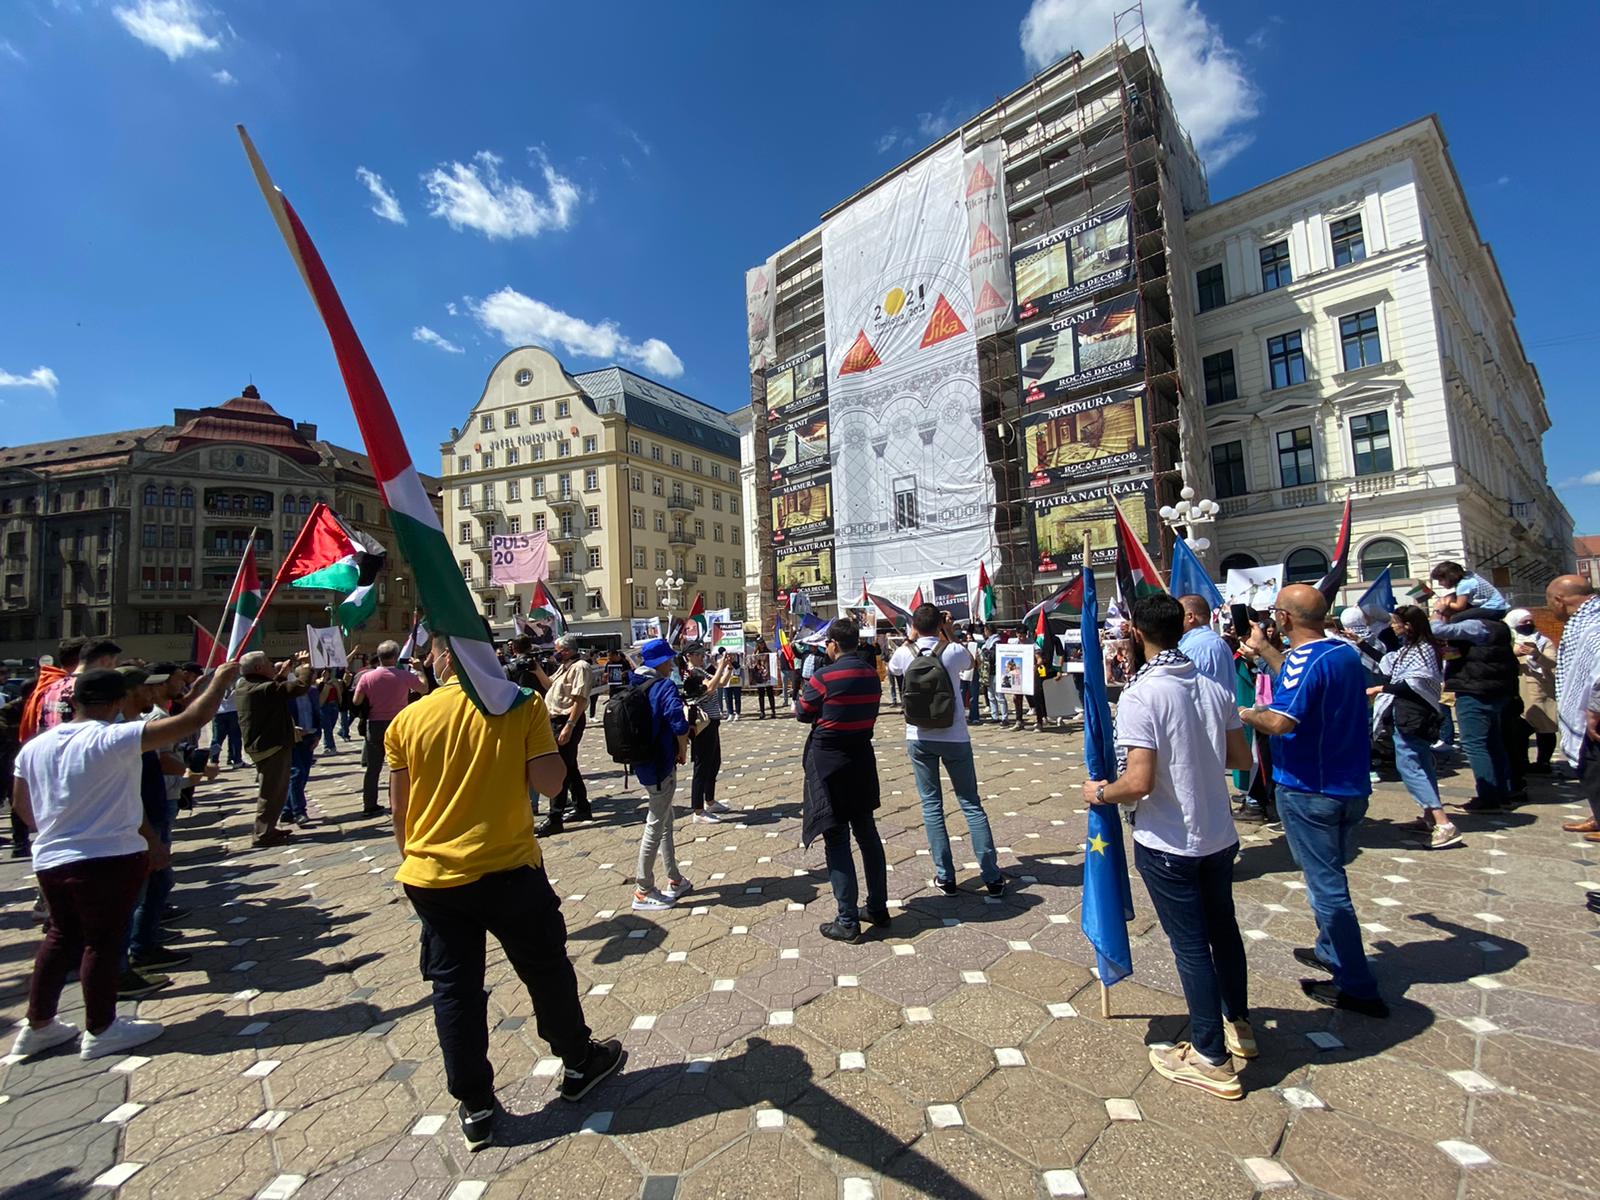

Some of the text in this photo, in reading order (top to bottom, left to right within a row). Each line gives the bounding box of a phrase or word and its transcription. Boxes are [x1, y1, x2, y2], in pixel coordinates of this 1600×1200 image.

[1035, 216, 1102, 250] TRAVERTIN
[1052, 282, 1085, 300] ROCAS
[1087, 269, 1122, 286] DECOR
[924, 308, 959, 343] Sika
[1049, 308, 1098, 331] GRANIT
[777, 353, 811, 373] TRAVERTIN
[1059, 370, 1092, 387] ROCAS
[1095, 360, 1131, 376] DECOR
[1048, 395, 1113, 420] MARMURA
[785, 418, 808, 431] GRANIT
[1064, 460, 1098, 473] ROCAS
[1100, 451, 1138, 466] DECOR
[783, 480, 816, 493] MARMURA
[1035, 481, 1148, 508] PIATRA NATURALA
[494, 536, 529, 550] PULS
[777, 540, 833, 555] PIATRA NATURALA
[494, 551, 514, 565] 20
[1071, 549, 1105, 561] ROAS
[935, 597, 968, 607] PALESTINE
